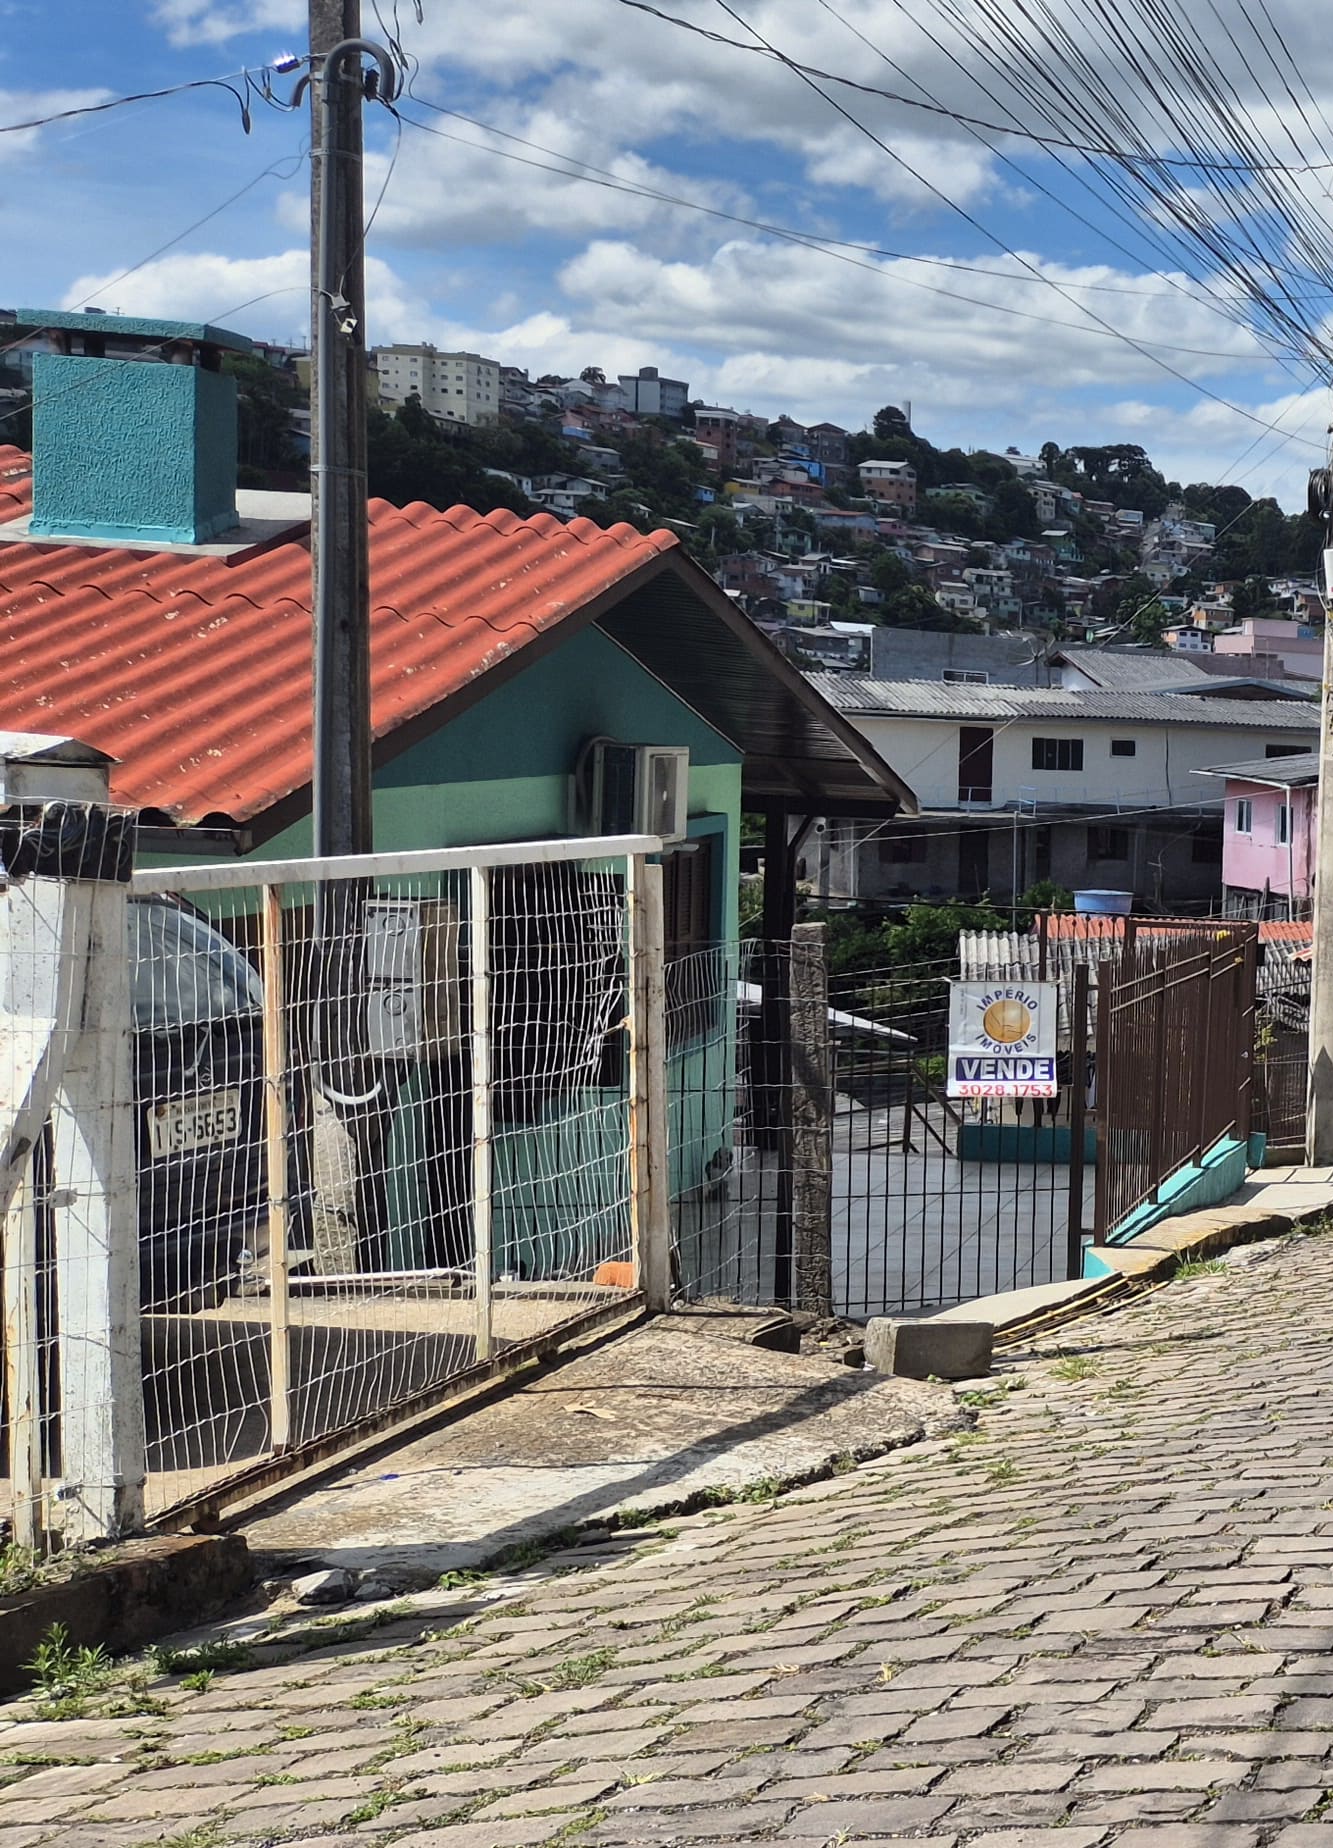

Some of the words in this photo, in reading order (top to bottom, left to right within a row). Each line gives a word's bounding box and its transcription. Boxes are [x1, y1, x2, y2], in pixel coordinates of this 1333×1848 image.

[976, 986, 1038, 1011] IMPÉRIO
[961, 1058, 1050, 1080] VENDE
[959, 1084, 1053, 1097] 3028.1753
